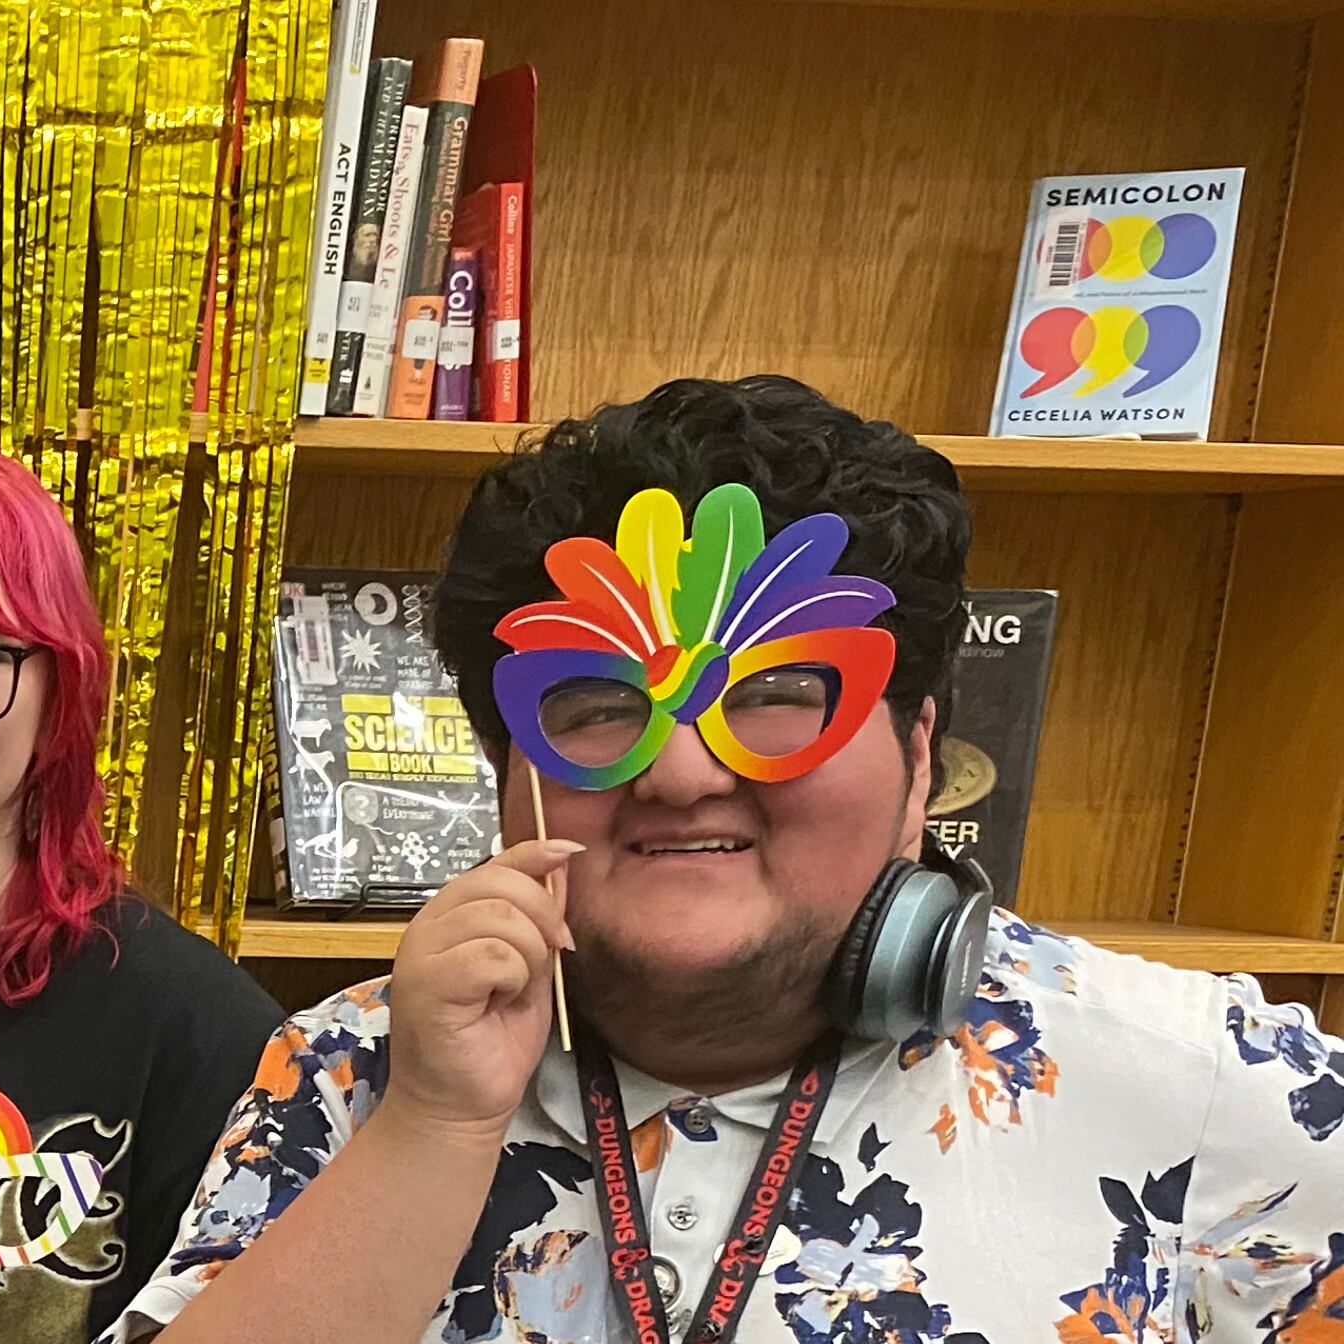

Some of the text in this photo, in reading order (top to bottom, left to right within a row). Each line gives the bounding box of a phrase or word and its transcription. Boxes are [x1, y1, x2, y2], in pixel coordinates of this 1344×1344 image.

[363, 142, 385, 217] MADMAN
[376, 114, 401, 213] PROFESSOR
[437, 116, 468, 243] Grammar Girl
[1046, 182, 1227, 207] SEMICOLON
[324, 142, 352, 276] ACT ENGLISH
[389, 176, 410, 239] Shoots
[504, 243, 516, 296] JAPANESE
[1008, 408, 1186, 422] CECELIA WATSON
[343, 715, 476, 754] SCIENCE
[389, 755, 433, 774] BOOK
[595, 1117, 637, 1244] DUNGEONS
[743, 1099, 817, 1243] DUNGEONS
[611, 1247, 648, 1281] &
